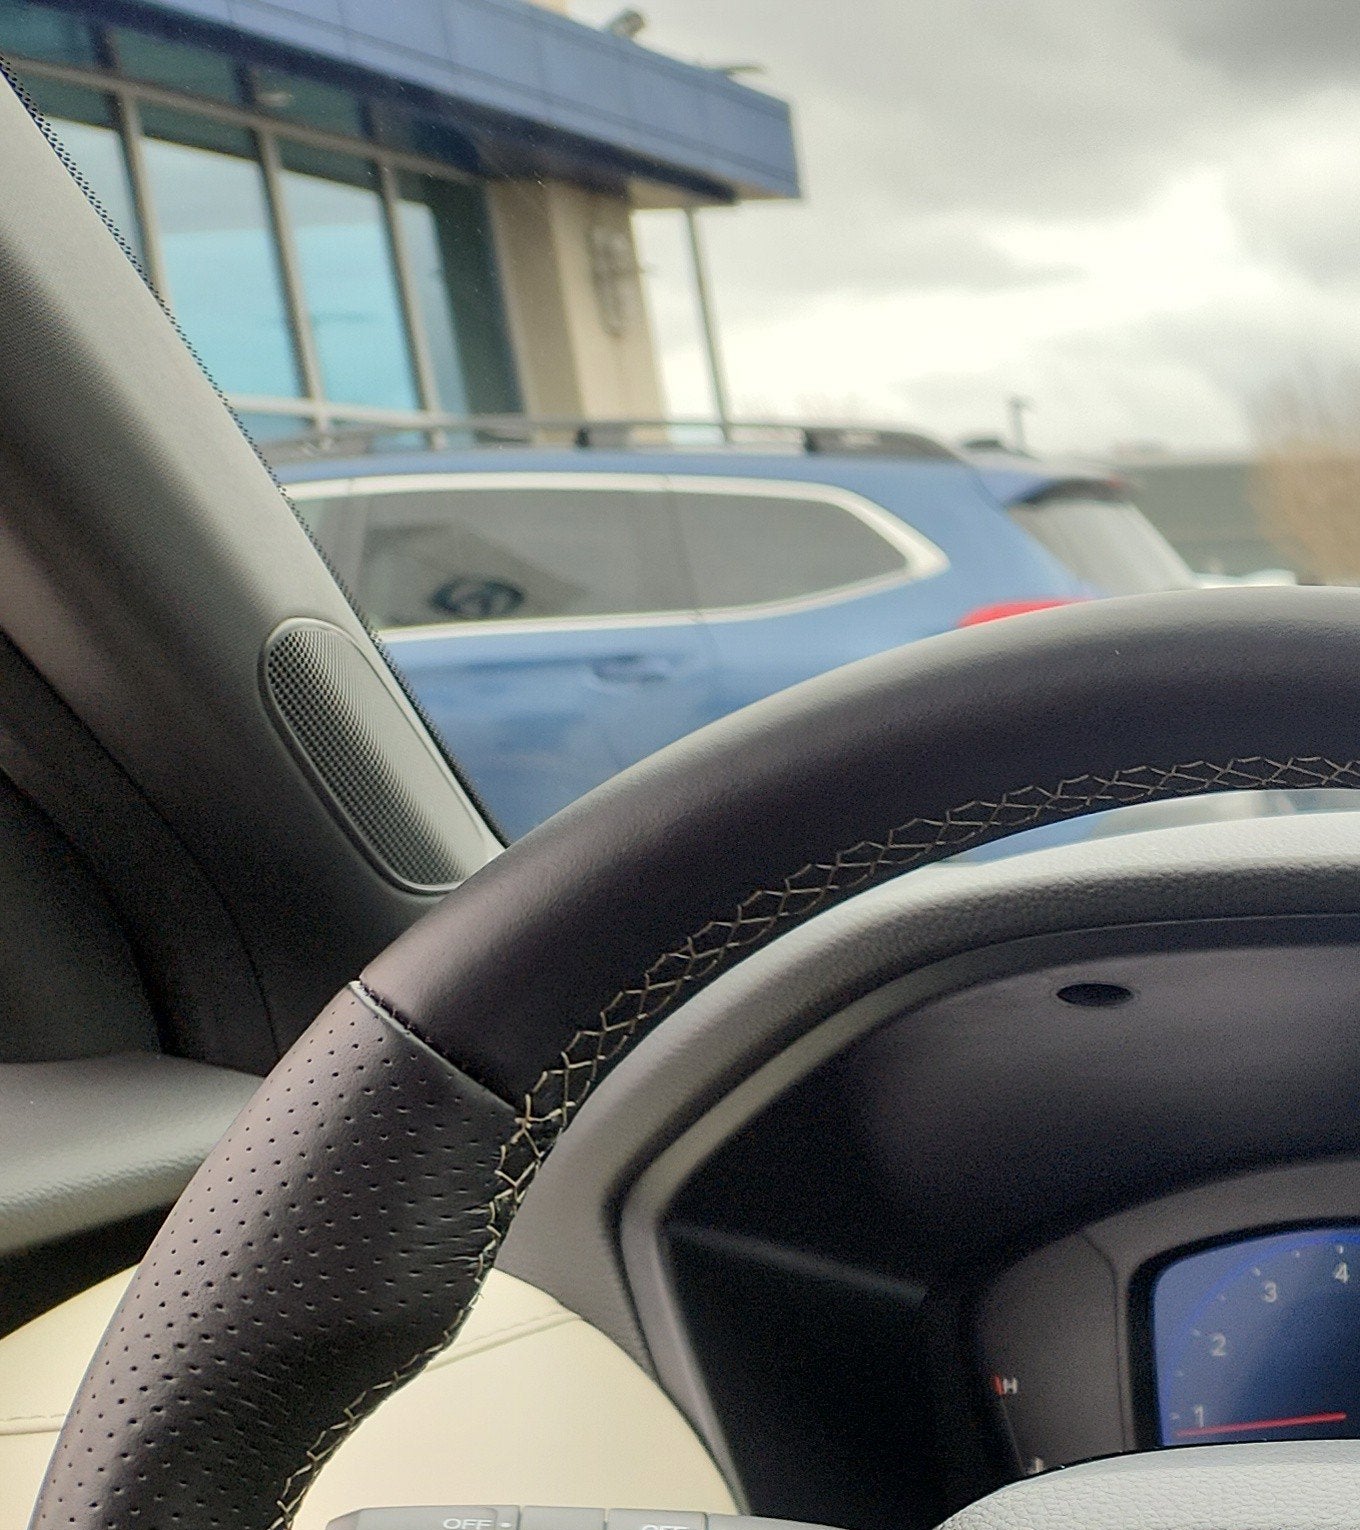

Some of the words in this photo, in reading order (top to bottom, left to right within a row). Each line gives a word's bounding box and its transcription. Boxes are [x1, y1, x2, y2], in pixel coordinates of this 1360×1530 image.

[1334, 1263, 1350, 1284] 4
[1263, 1282, 1279, 1303] 3
[1211, 1334, 1228, 1357] 2
[1003, 1377, 1018, 1394] H
